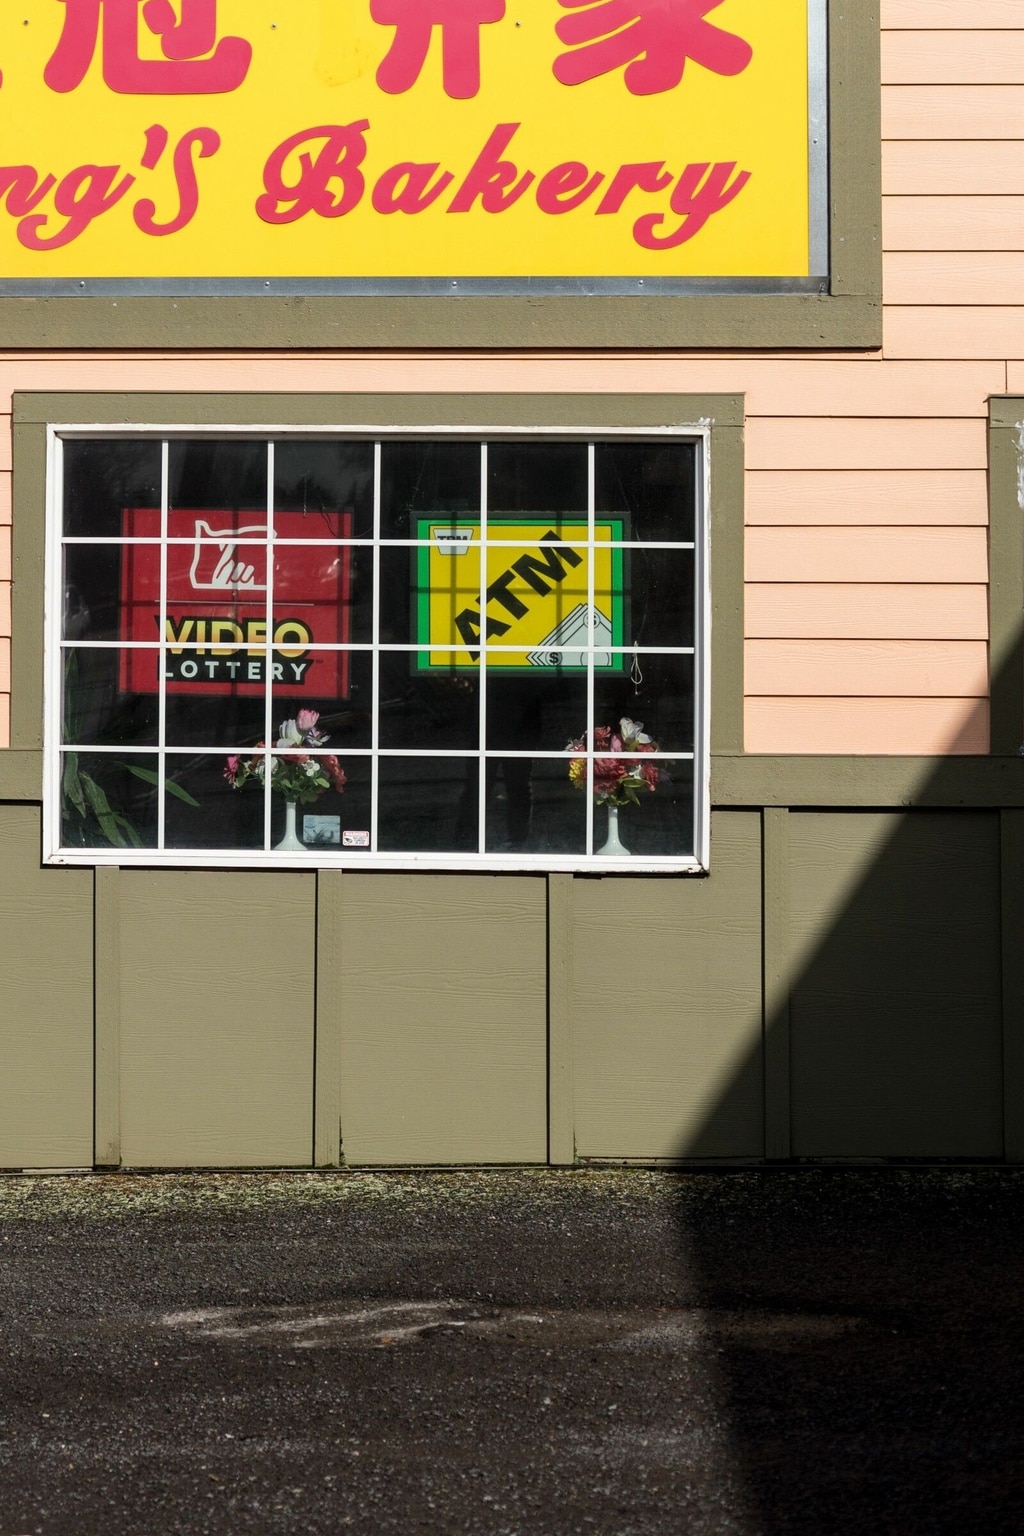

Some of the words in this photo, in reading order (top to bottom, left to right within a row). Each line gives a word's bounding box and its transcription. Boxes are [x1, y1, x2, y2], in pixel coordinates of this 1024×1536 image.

[255, 119, 752, 250] Bakery
[163, 620, 310, 658] VIDEO
[454, 530, 583, 662] ATM
